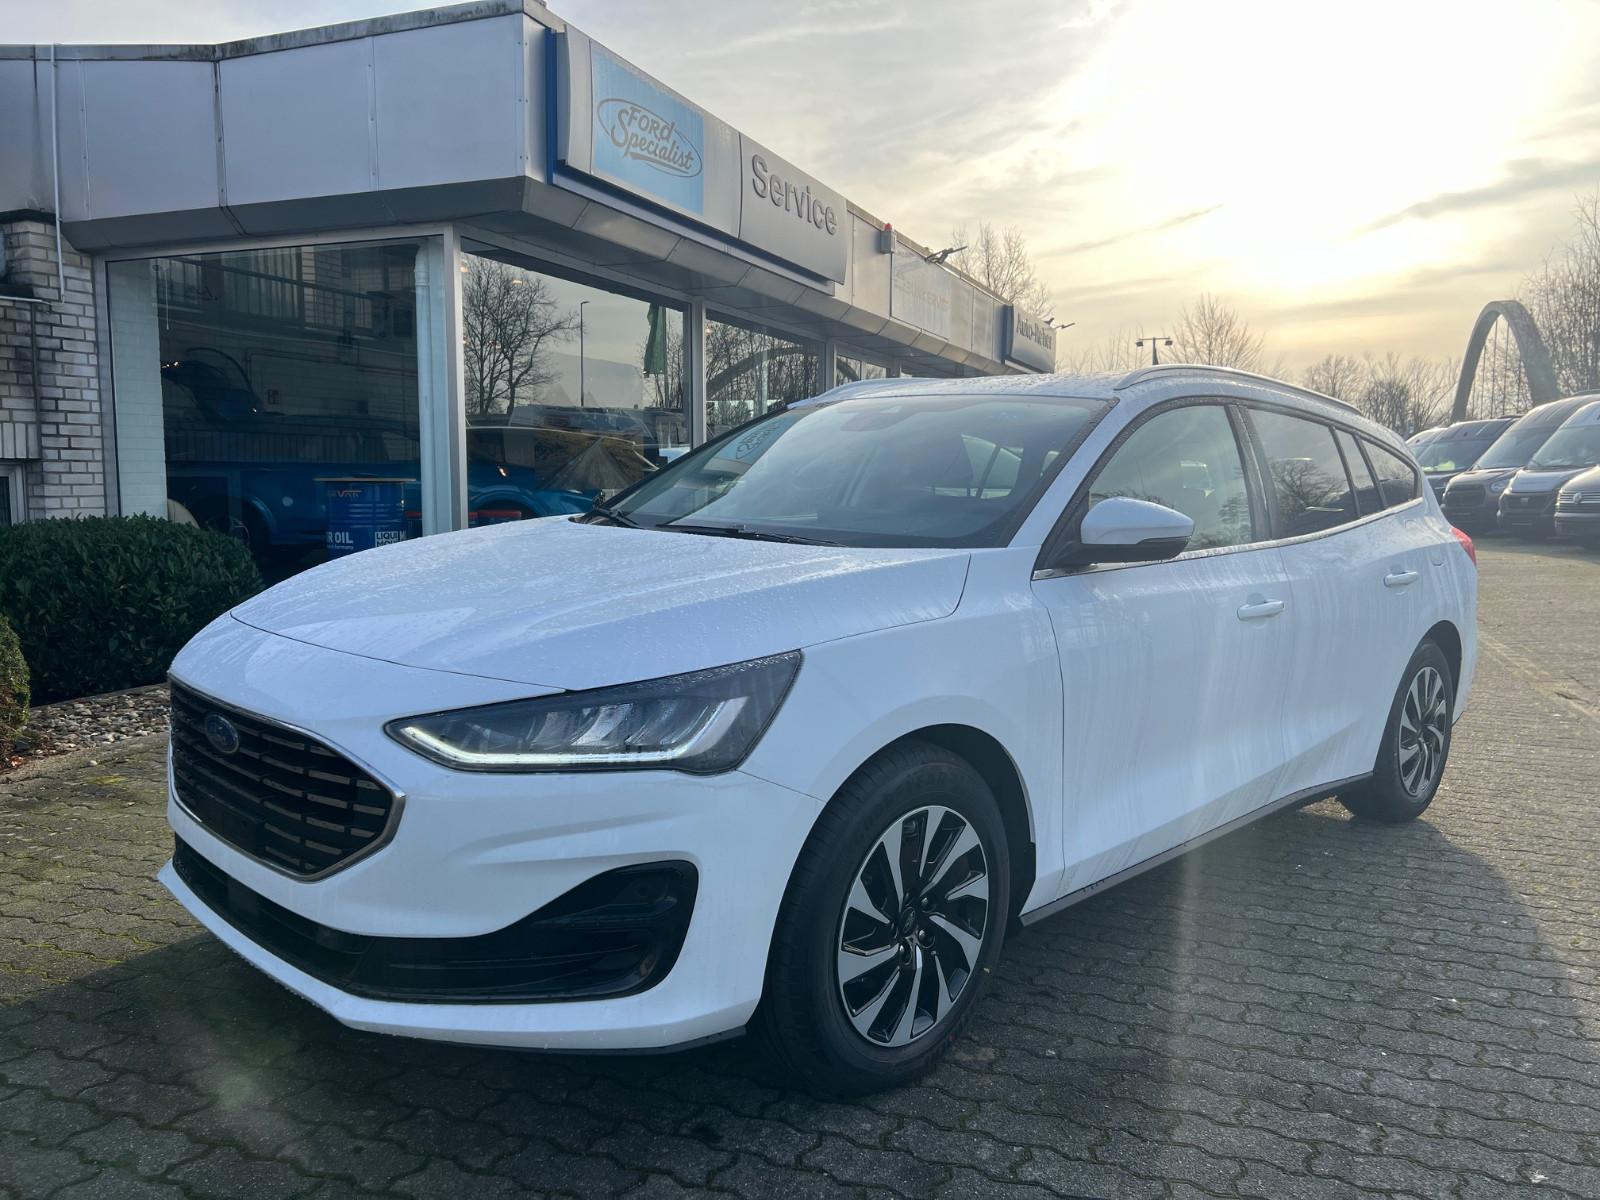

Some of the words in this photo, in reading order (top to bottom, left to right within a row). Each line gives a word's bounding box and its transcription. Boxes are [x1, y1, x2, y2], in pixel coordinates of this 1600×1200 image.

[611, 109, 693, 169] Specialist
[752, 154, 837, 235] Service
[334, 531, 354, 544] OIL
[376, 532, 398, 540] LIQUI
